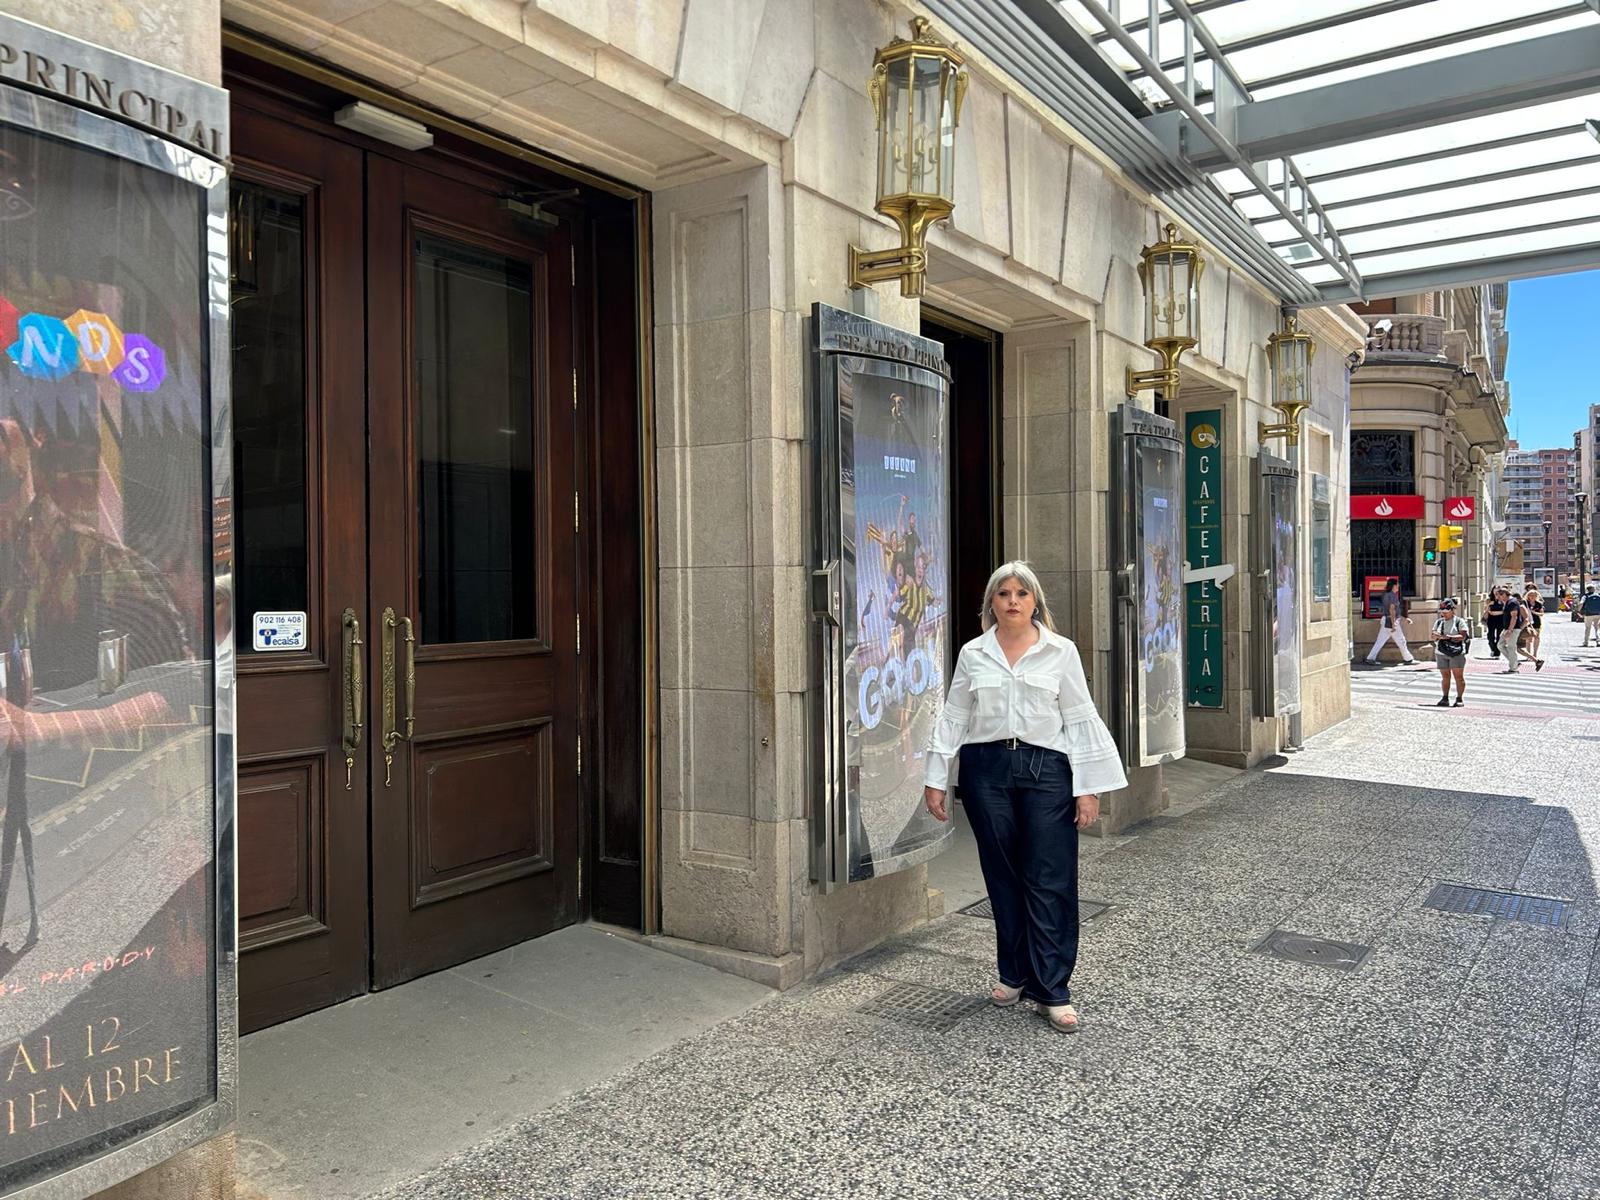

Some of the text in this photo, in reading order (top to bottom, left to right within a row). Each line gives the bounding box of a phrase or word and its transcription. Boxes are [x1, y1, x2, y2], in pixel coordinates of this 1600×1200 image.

[835, 333, 908, 359] TEATRO
[1199, 455, 1211, 676] CAFETERÍA
[259, 616, 274, 624] 902
[7, 1016, 121, 1082] AL 12
